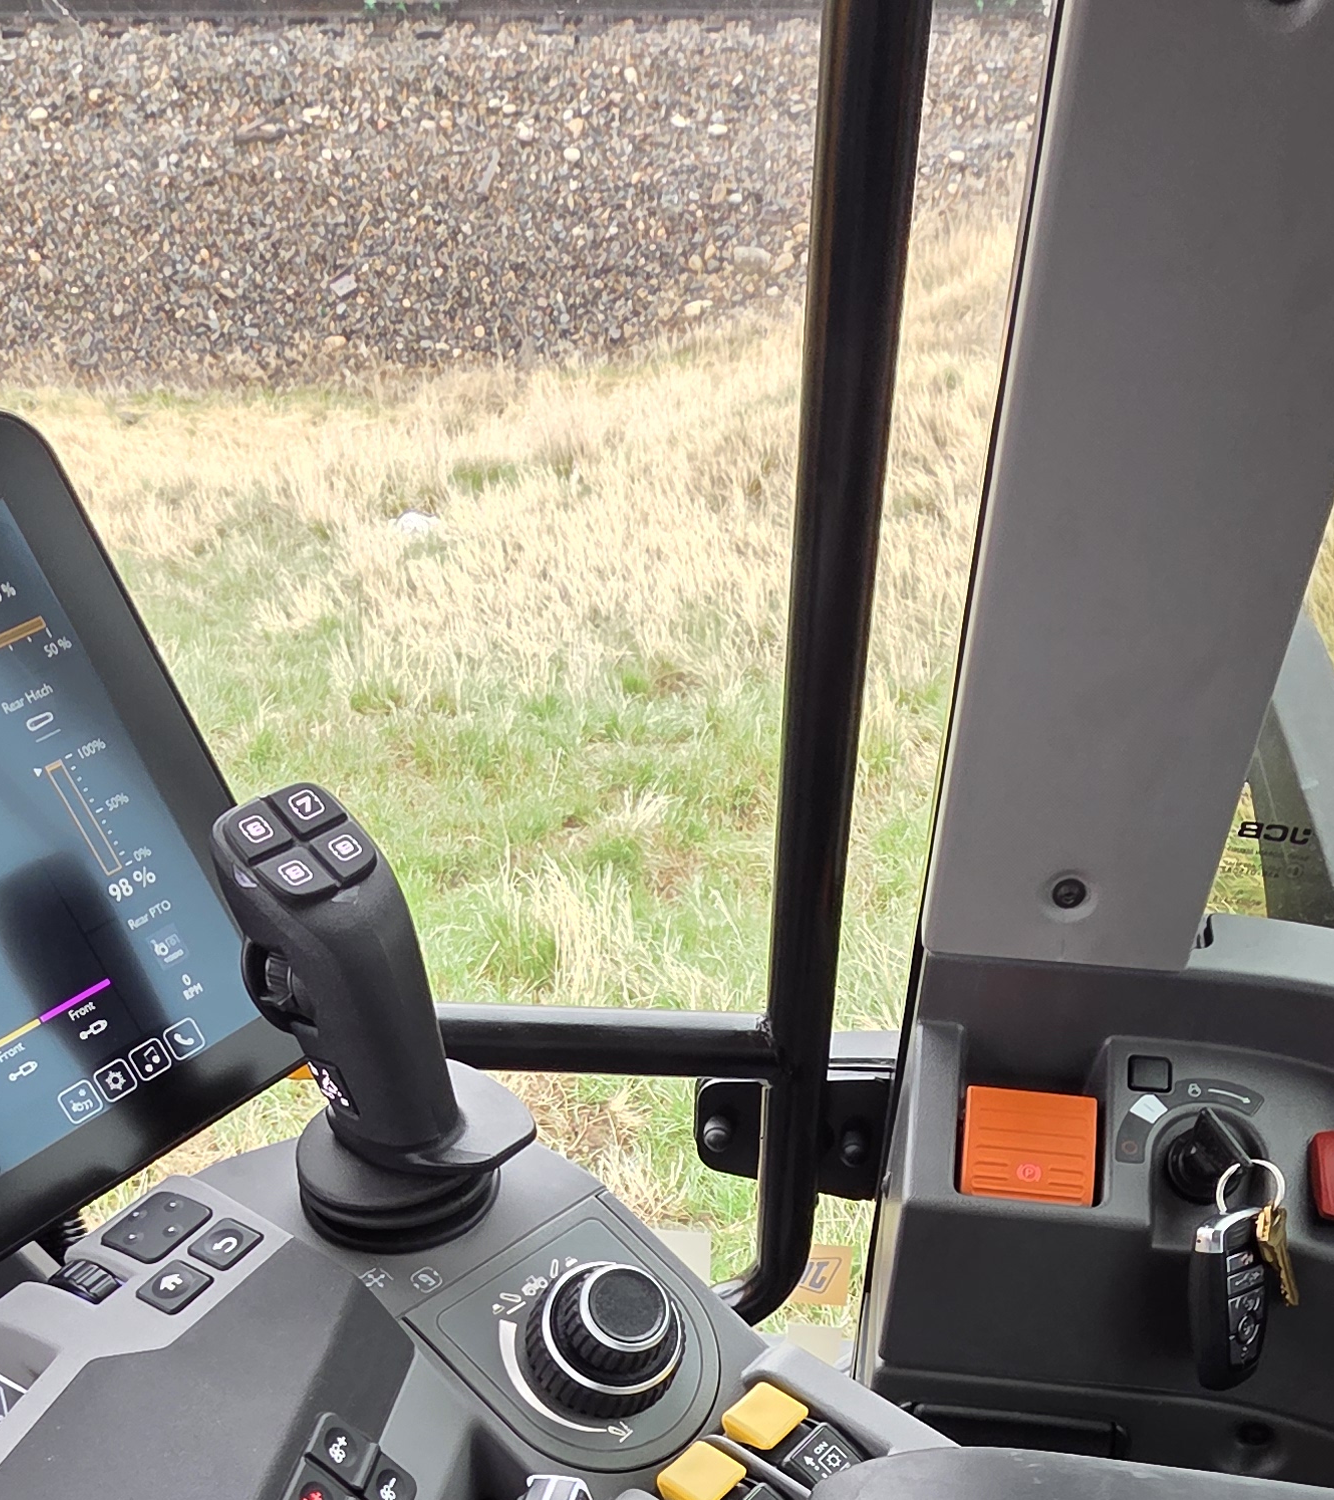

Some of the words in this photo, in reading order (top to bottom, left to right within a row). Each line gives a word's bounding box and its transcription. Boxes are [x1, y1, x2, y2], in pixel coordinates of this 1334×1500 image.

[1, 697, 25, 714] Rear
[24, 683, 53, 704] Hitch
[77, 738, 106, 759] 100%
[127, 914, 148, 930] Rear
[148, 900, 171, 918] PTO
[183, 983, 203, 1000] RPM
[68, 1001, 96, 1021] Front
[814, 1441, 828, 1455] ON
